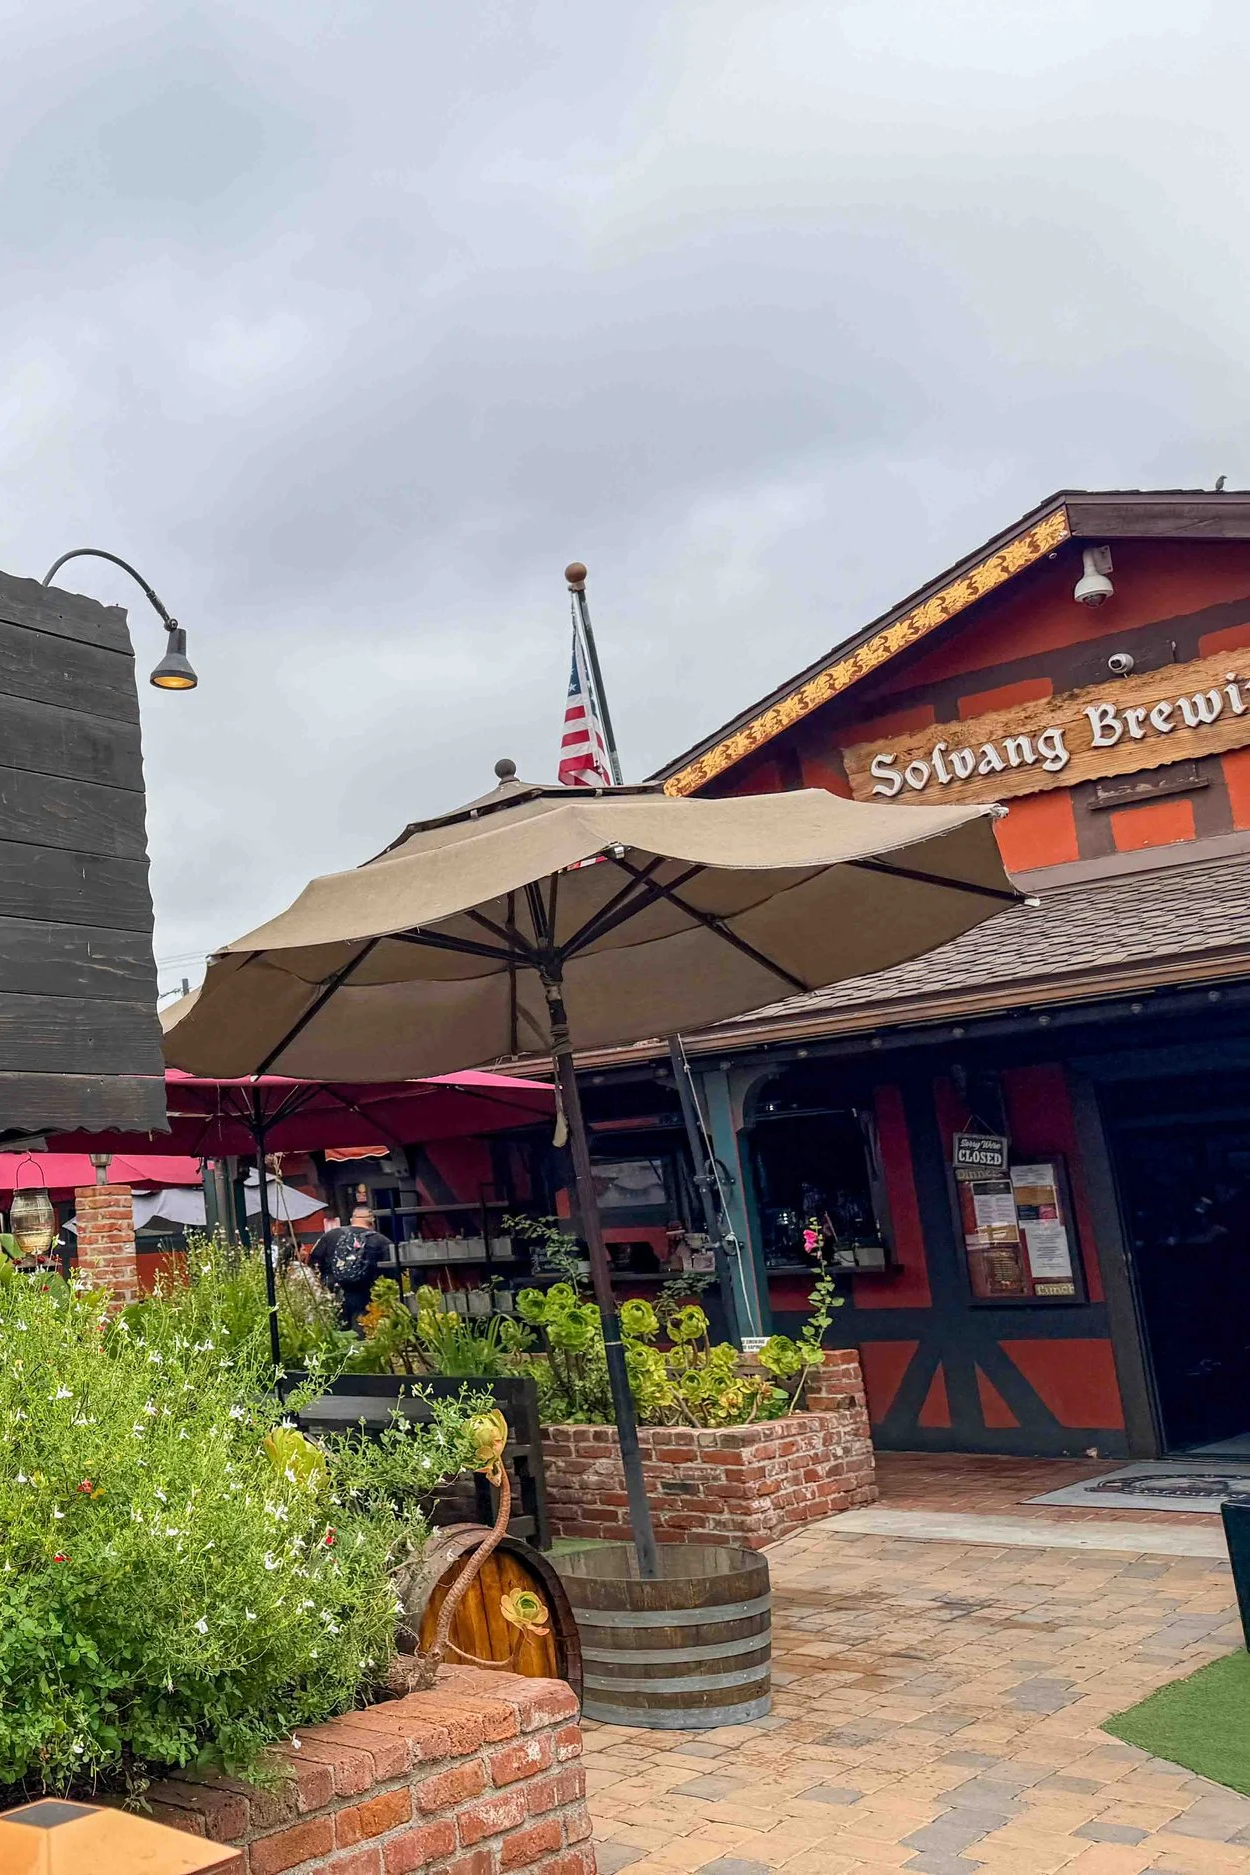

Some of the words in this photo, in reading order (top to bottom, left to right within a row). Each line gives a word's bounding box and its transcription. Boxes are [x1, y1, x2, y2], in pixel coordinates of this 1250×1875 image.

[869, 726, 1072, 797] Solvang
[1083, 671, 1250, 748] Brewi
[958, 1150, 1002, 1165] CLOSED
